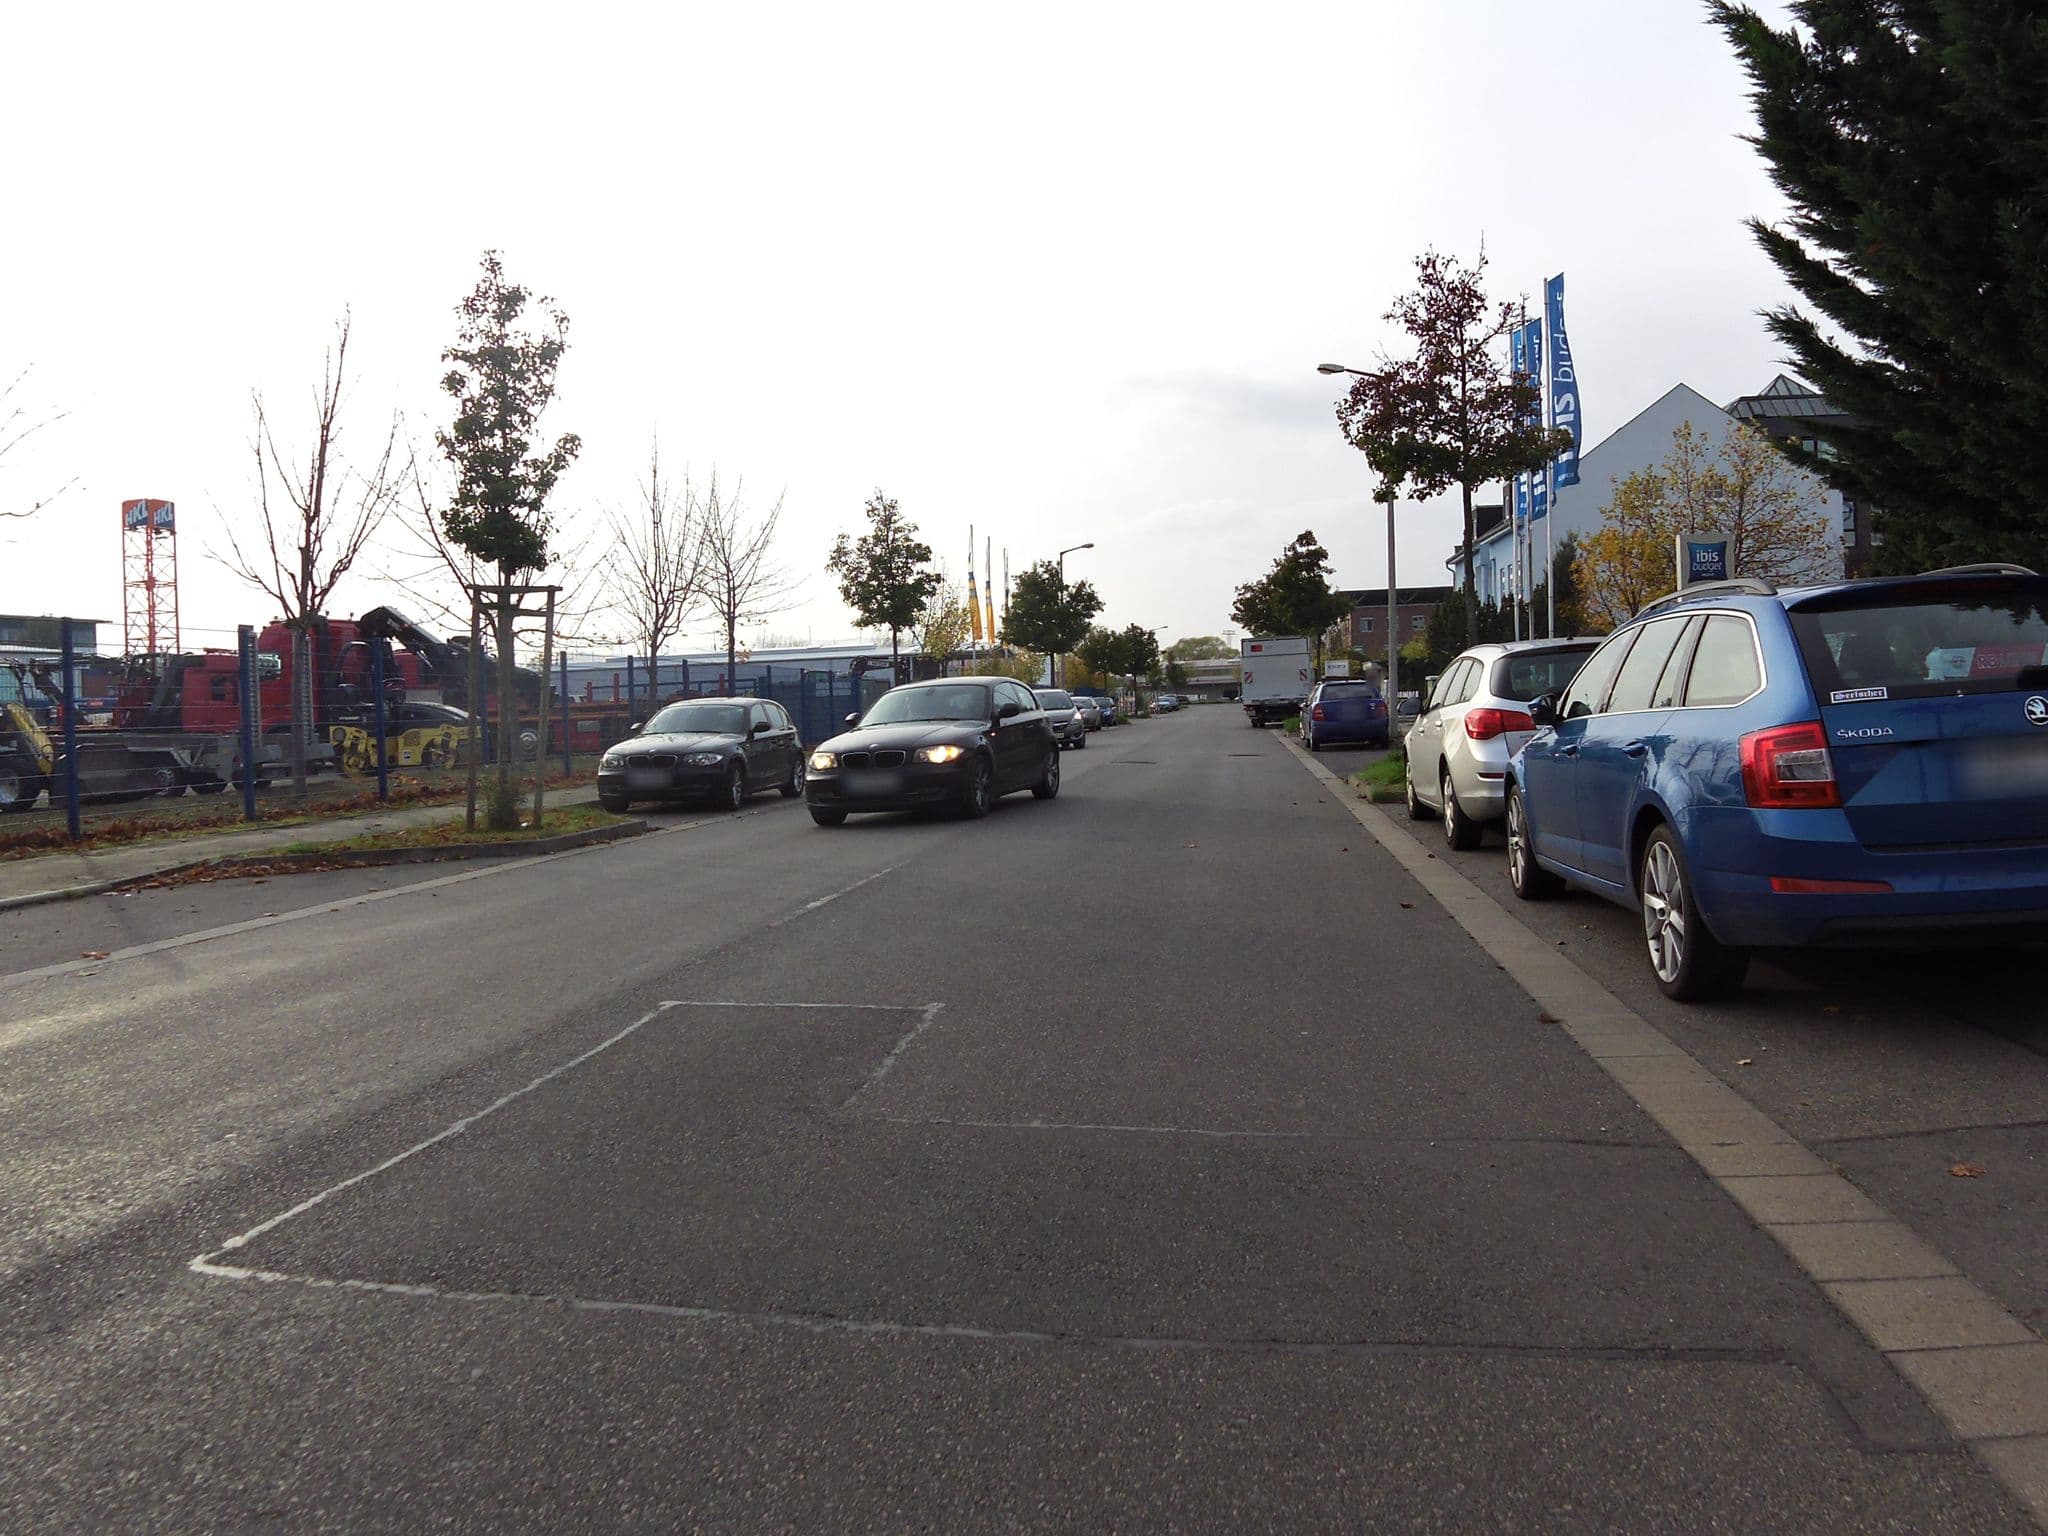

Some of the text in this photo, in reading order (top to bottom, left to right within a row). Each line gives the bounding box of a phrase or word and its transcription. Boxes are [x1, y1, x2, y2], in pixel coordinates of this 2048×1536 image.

[125, 500, 148, 526] HKL
[153, 502, 173, 526] HKL
[1696, 549, 1719, 562] ibis
[1692, 562, 1722, 572] budget
